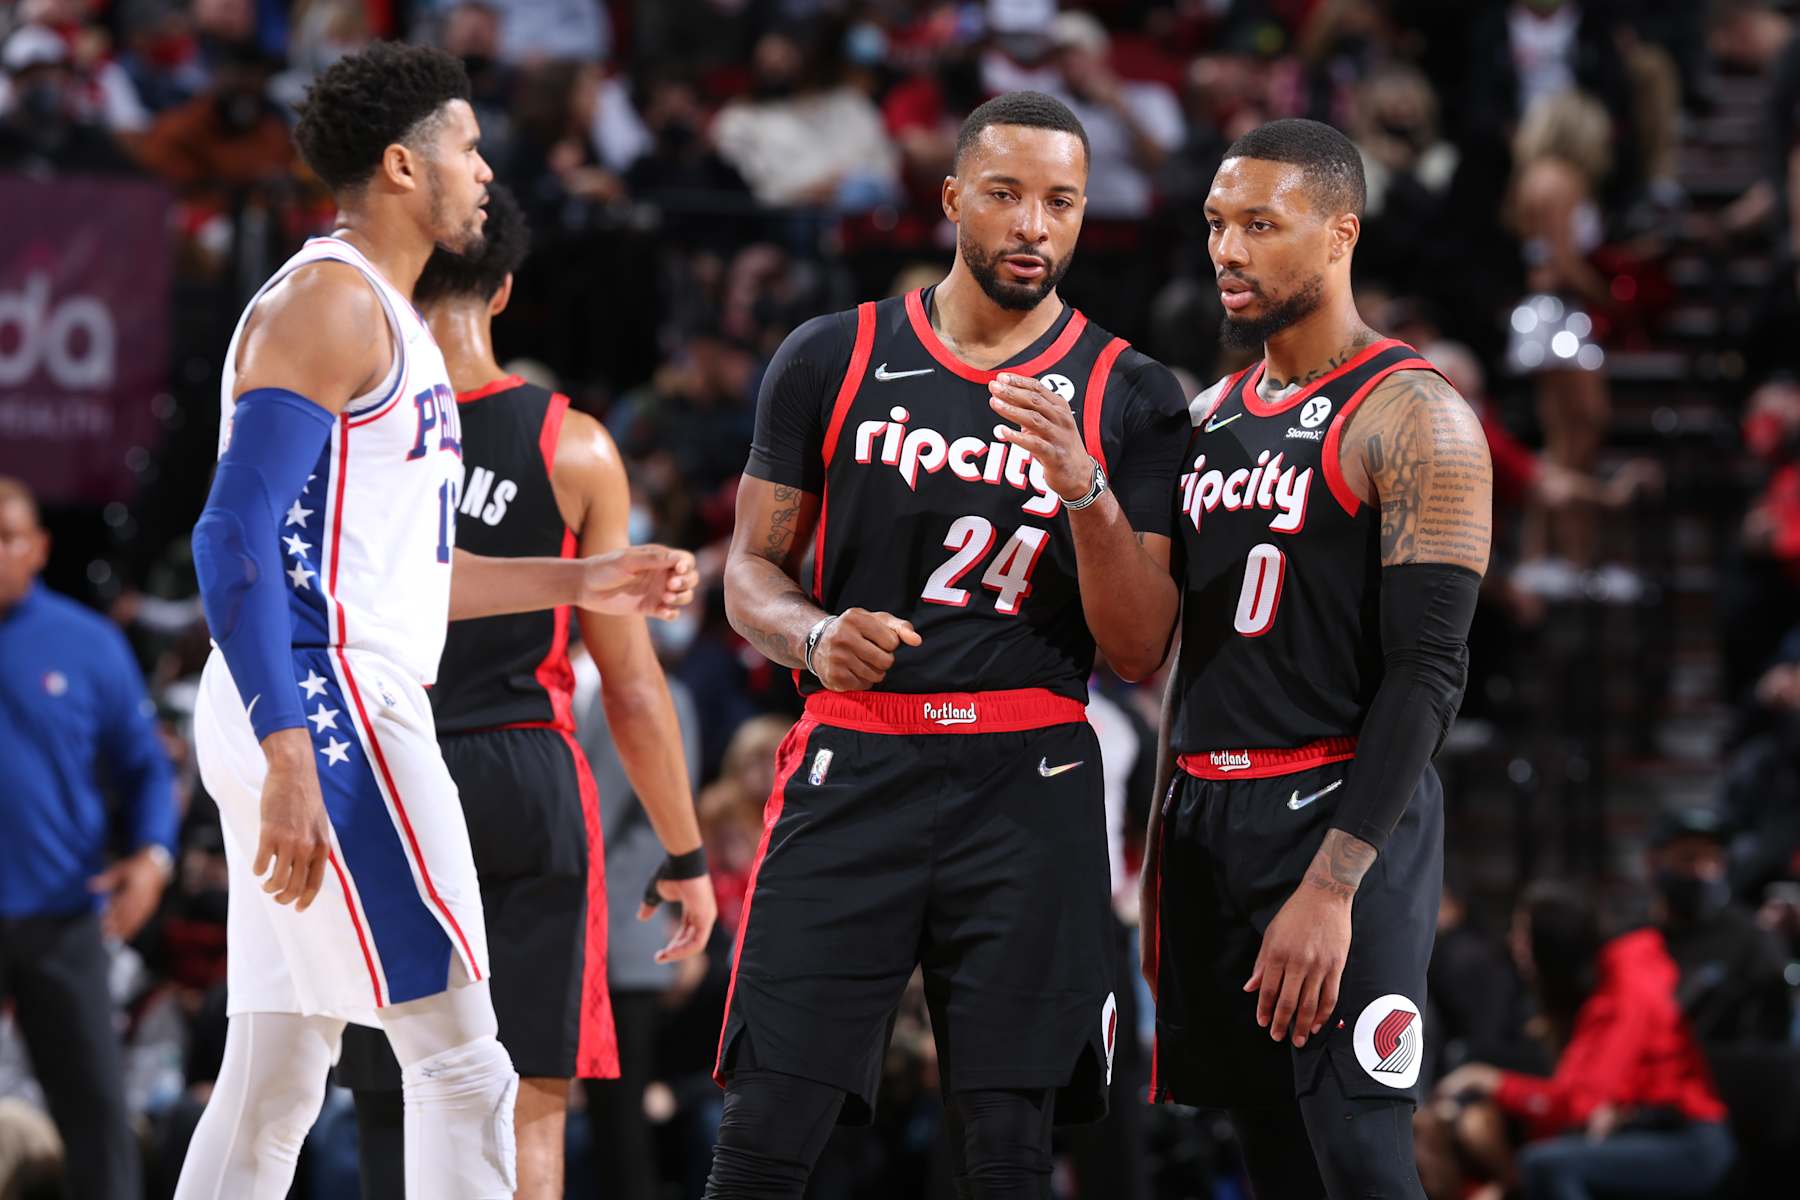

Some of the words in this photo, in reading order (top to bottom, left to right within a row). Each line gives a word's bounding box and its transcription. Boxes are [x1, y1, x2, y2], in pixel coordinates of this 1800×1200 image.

[1285, 427, 1321, 440] StormX
[436, 478, 456, 564] 1
[921, 516, 1050, 616] 24
[1234, 543, 1287, 637] 0
[923, 702, 976, 726] Portland
[1210, 749, 1251, 772] Portland
